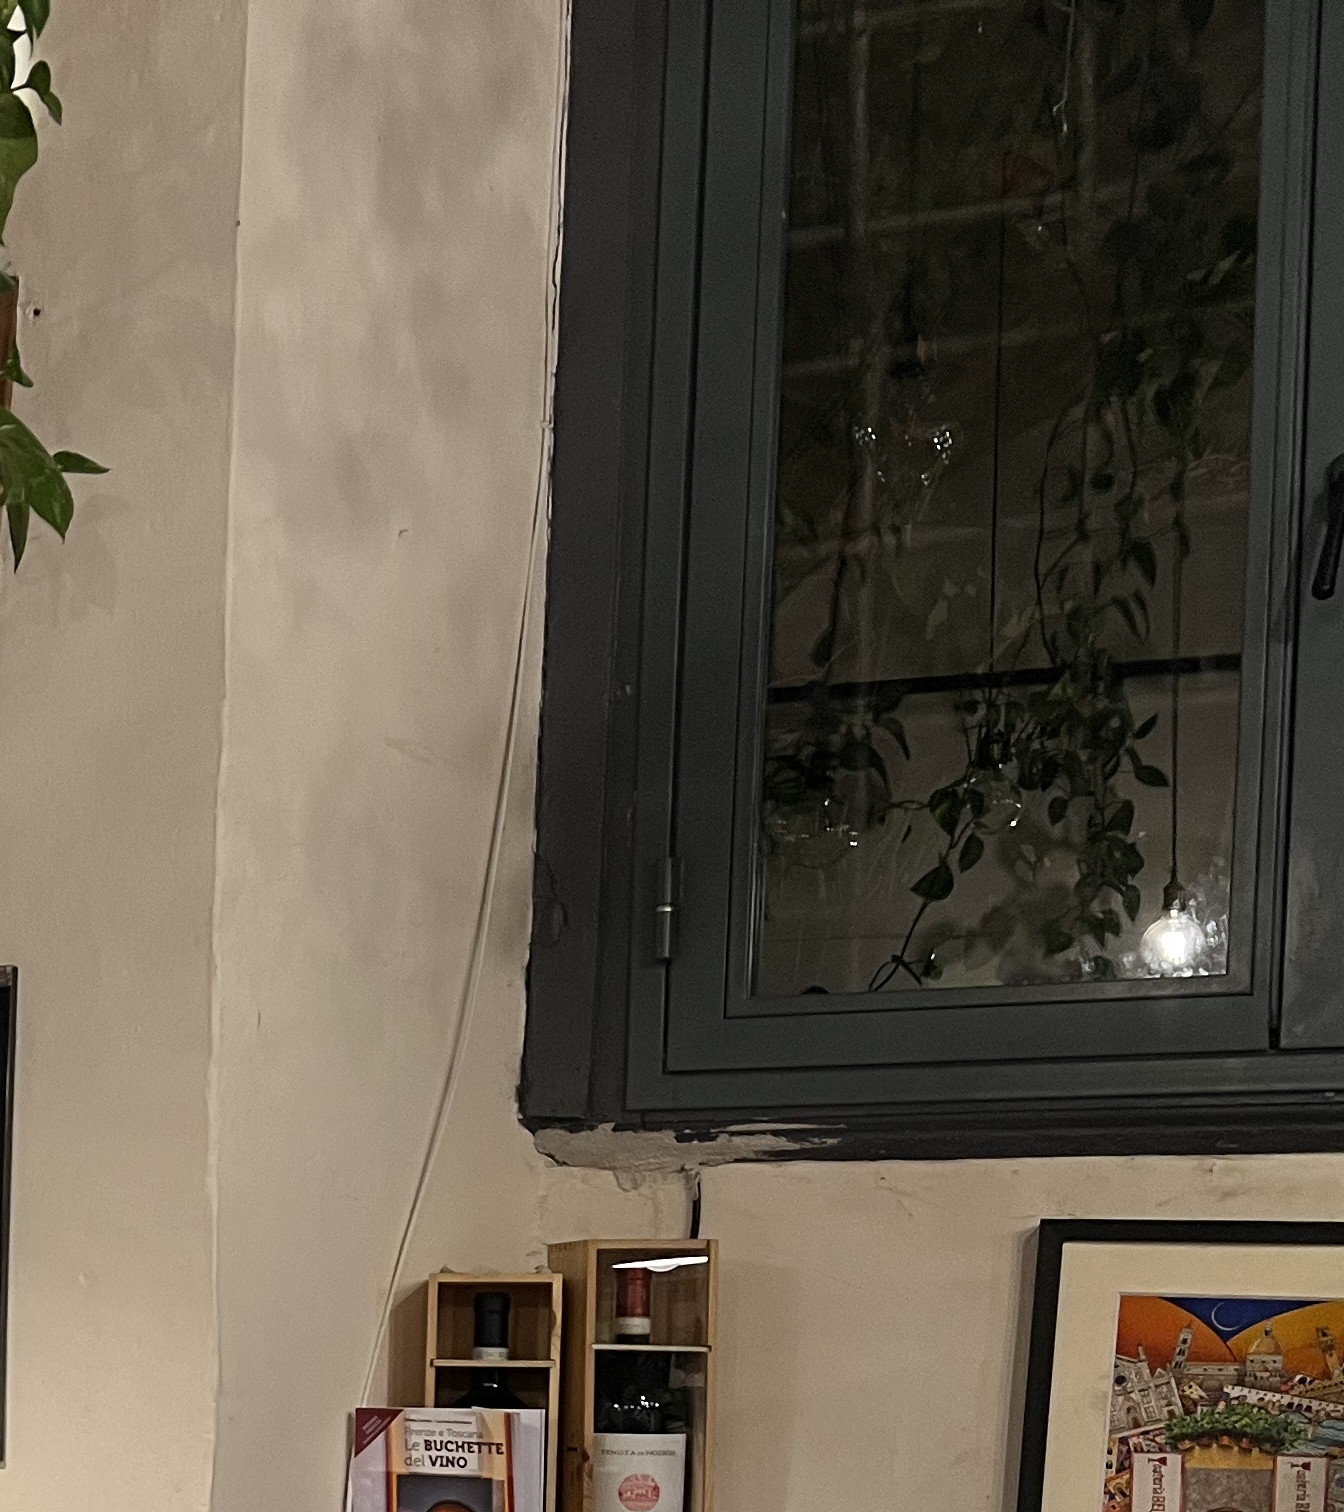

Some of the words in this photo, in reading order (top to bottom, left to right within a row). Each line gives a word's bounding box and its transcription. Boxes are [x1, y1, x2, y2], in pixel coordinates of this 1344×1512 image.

[404, 1427, 437, 1437] Firenze
[446, 1428, 484, 1439] Toscana
[404, 1439, 421, 1451] Le
[423, 1439, 505, 1455] BUCHETTE
[404, 1454, 426, 1468] del
[428, 1454, 468, 1469] VINO
